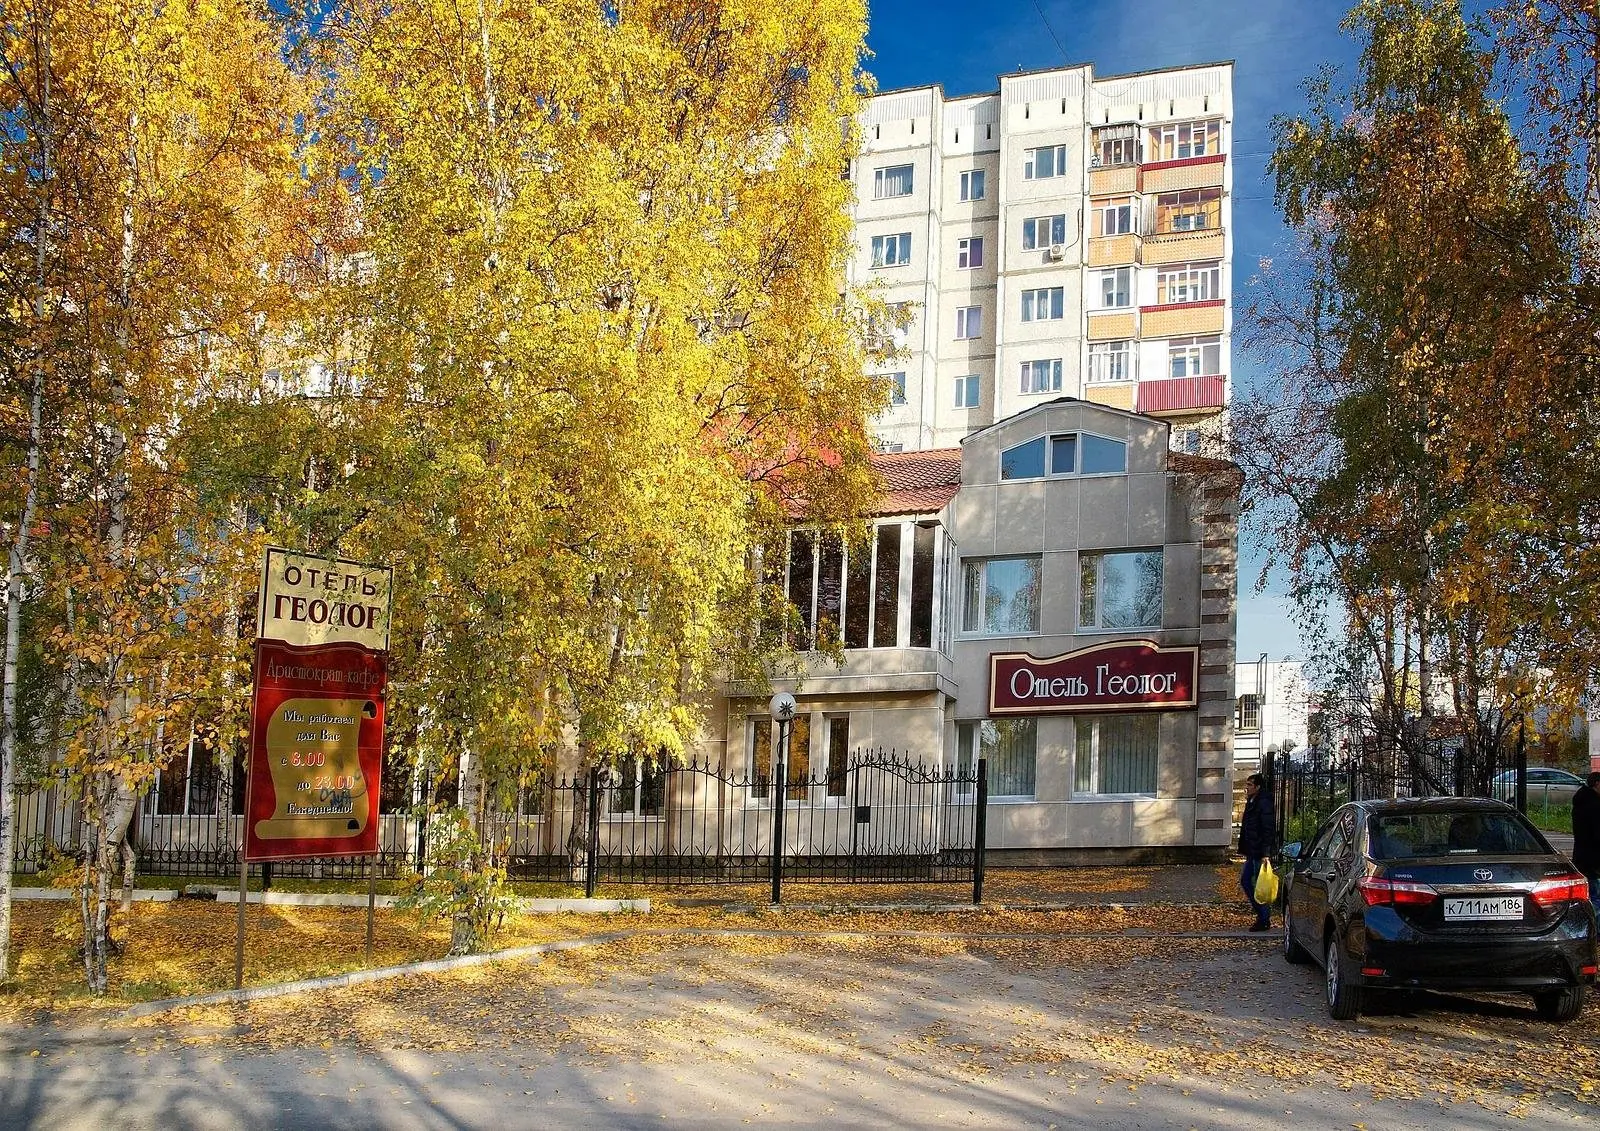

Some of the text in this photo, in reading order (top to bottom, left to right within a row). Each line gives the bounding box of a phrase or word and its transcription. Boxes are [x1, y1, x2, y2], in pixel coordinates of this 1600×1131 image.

[284, 565, 376, 596] ОТЕЛЬ
[273, 594, 382, 629] ГЕОЛОГ
[1010, 663, 1177, 699] Отель Геолог
[283, 710, 355, 726] Мы работаем
[296, 729, 341, 742] для Вас
[281, 757, 288, 766] с
[296, 781, 311, 791] до
[287, 802, 354, 817] Ежедневно!
[1501, 898, 1520, 910] 186
